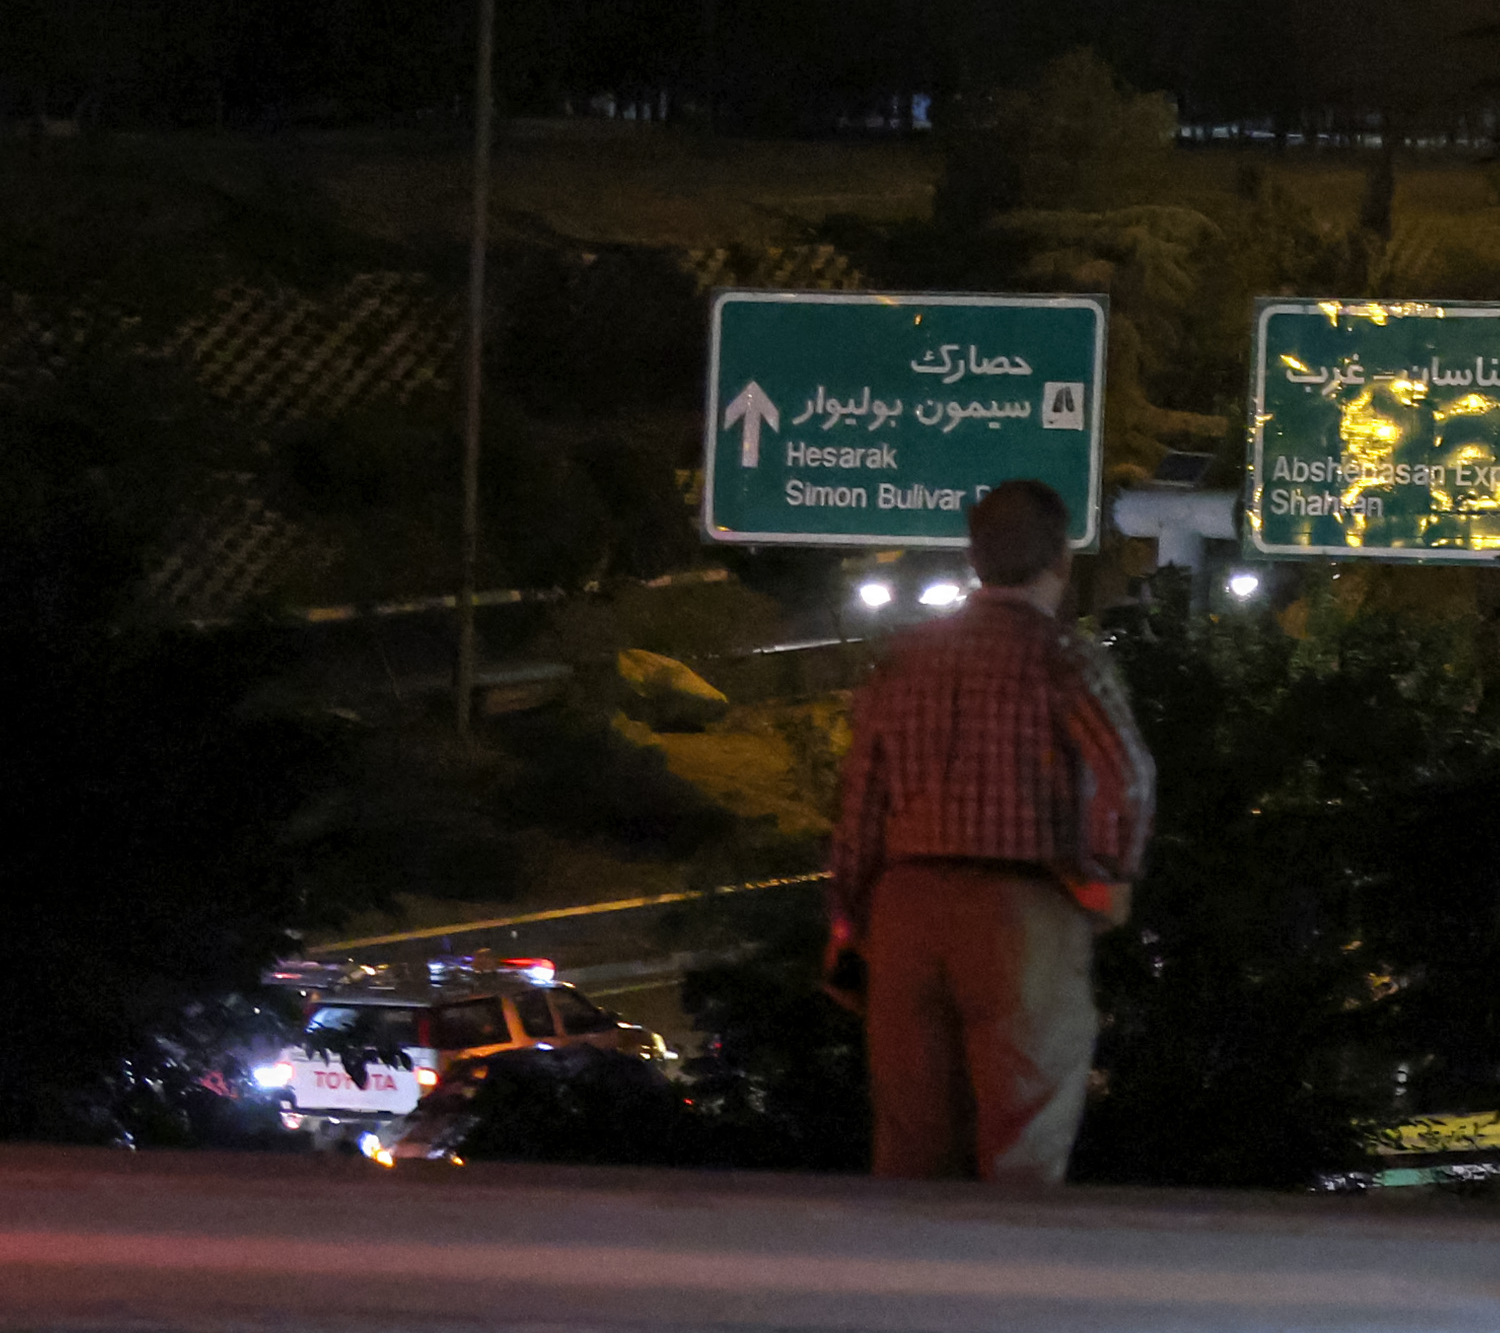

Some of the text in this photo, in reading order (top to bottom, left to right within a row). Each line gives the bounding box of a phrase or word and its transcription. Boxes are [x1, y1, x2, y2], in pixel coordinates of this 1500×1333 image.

[1285, 353, 1365, 397] غرب
[792, 385, 1032, 433] سیمون بولیوار
[786, 441, 898, 469] Hesarak
[785, 479, 867, 509] Simon
[877, 482, 966, 511] Bulivar
